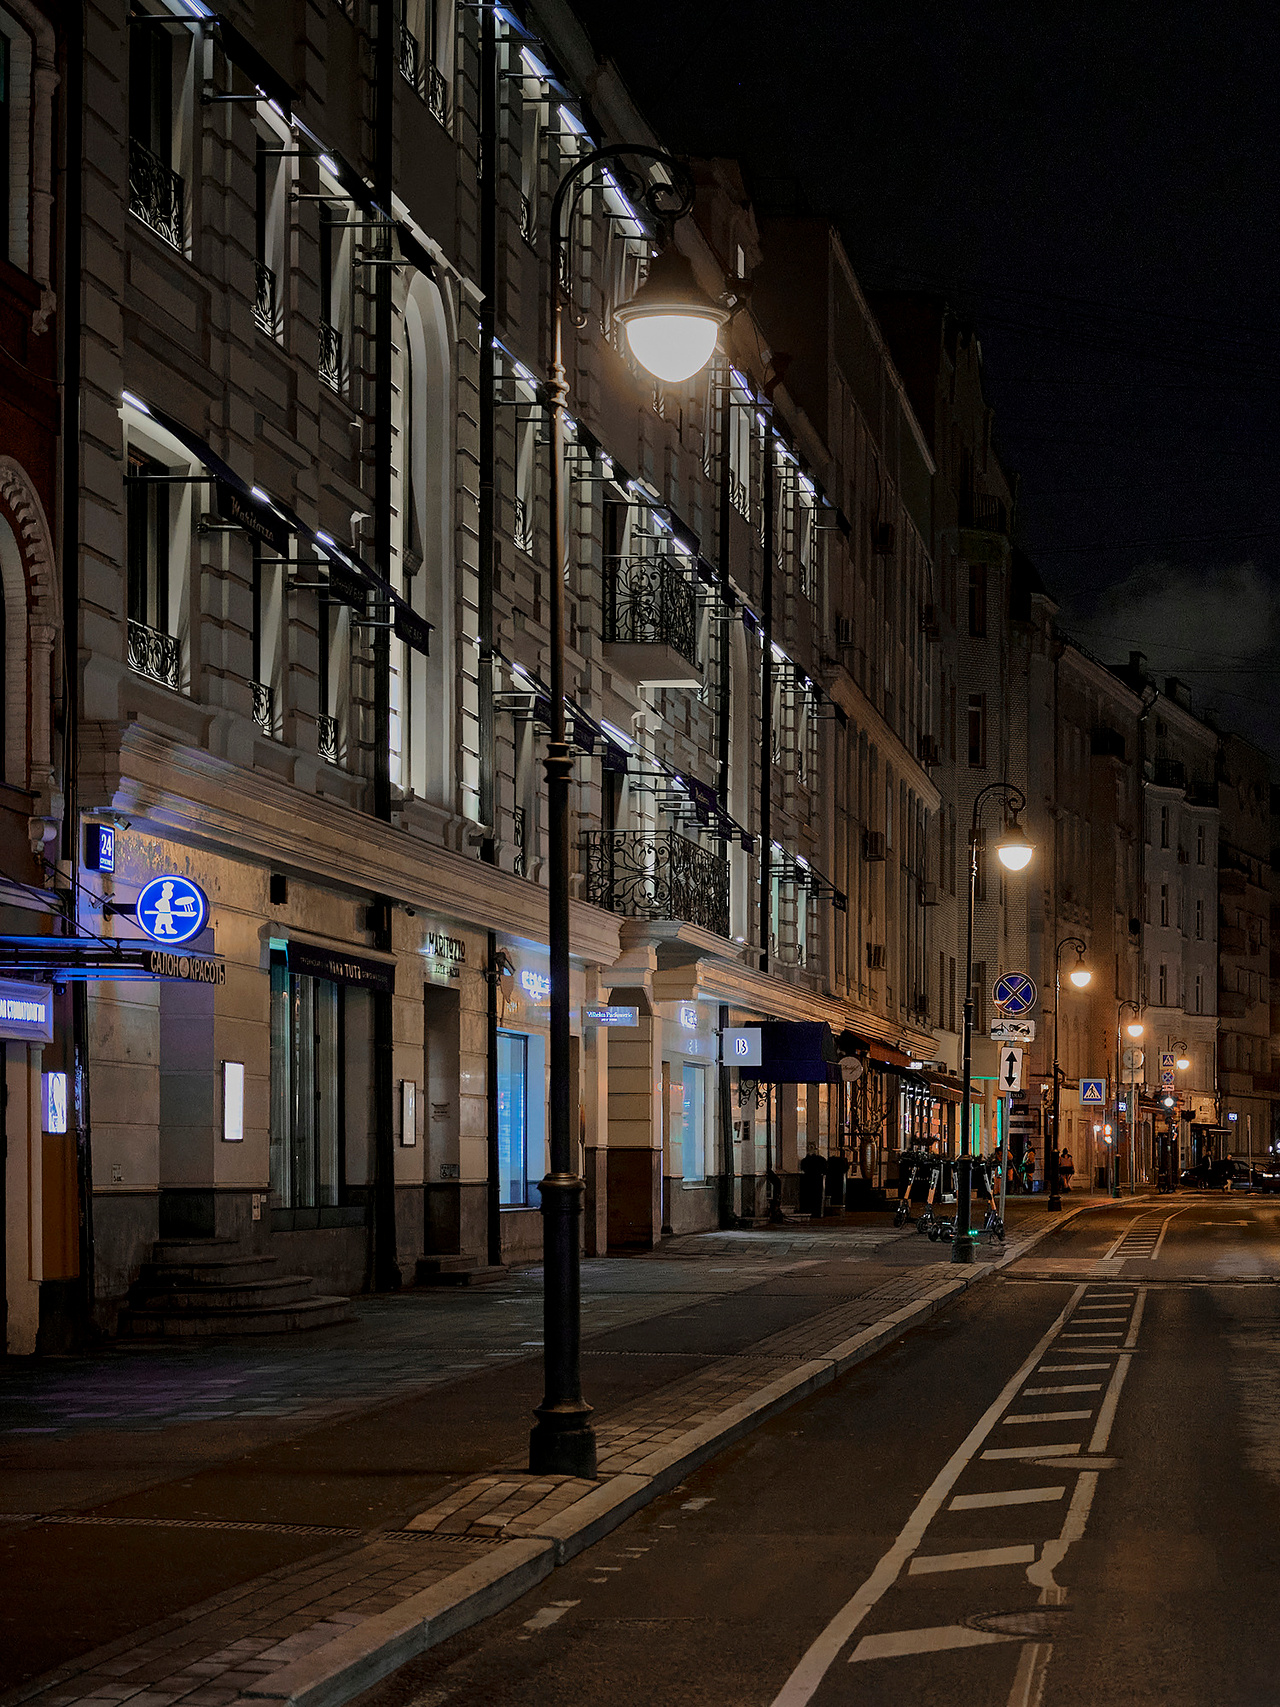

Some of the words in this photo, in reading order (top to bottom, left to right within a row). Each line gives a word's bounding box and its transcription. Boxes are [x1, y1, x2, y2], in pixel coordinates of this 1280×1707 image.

[101, 833, 112, 857] 24
[150, 950, 179, 977] САЛОН
[189, 957, 227, 985] КРАСОТЫ
